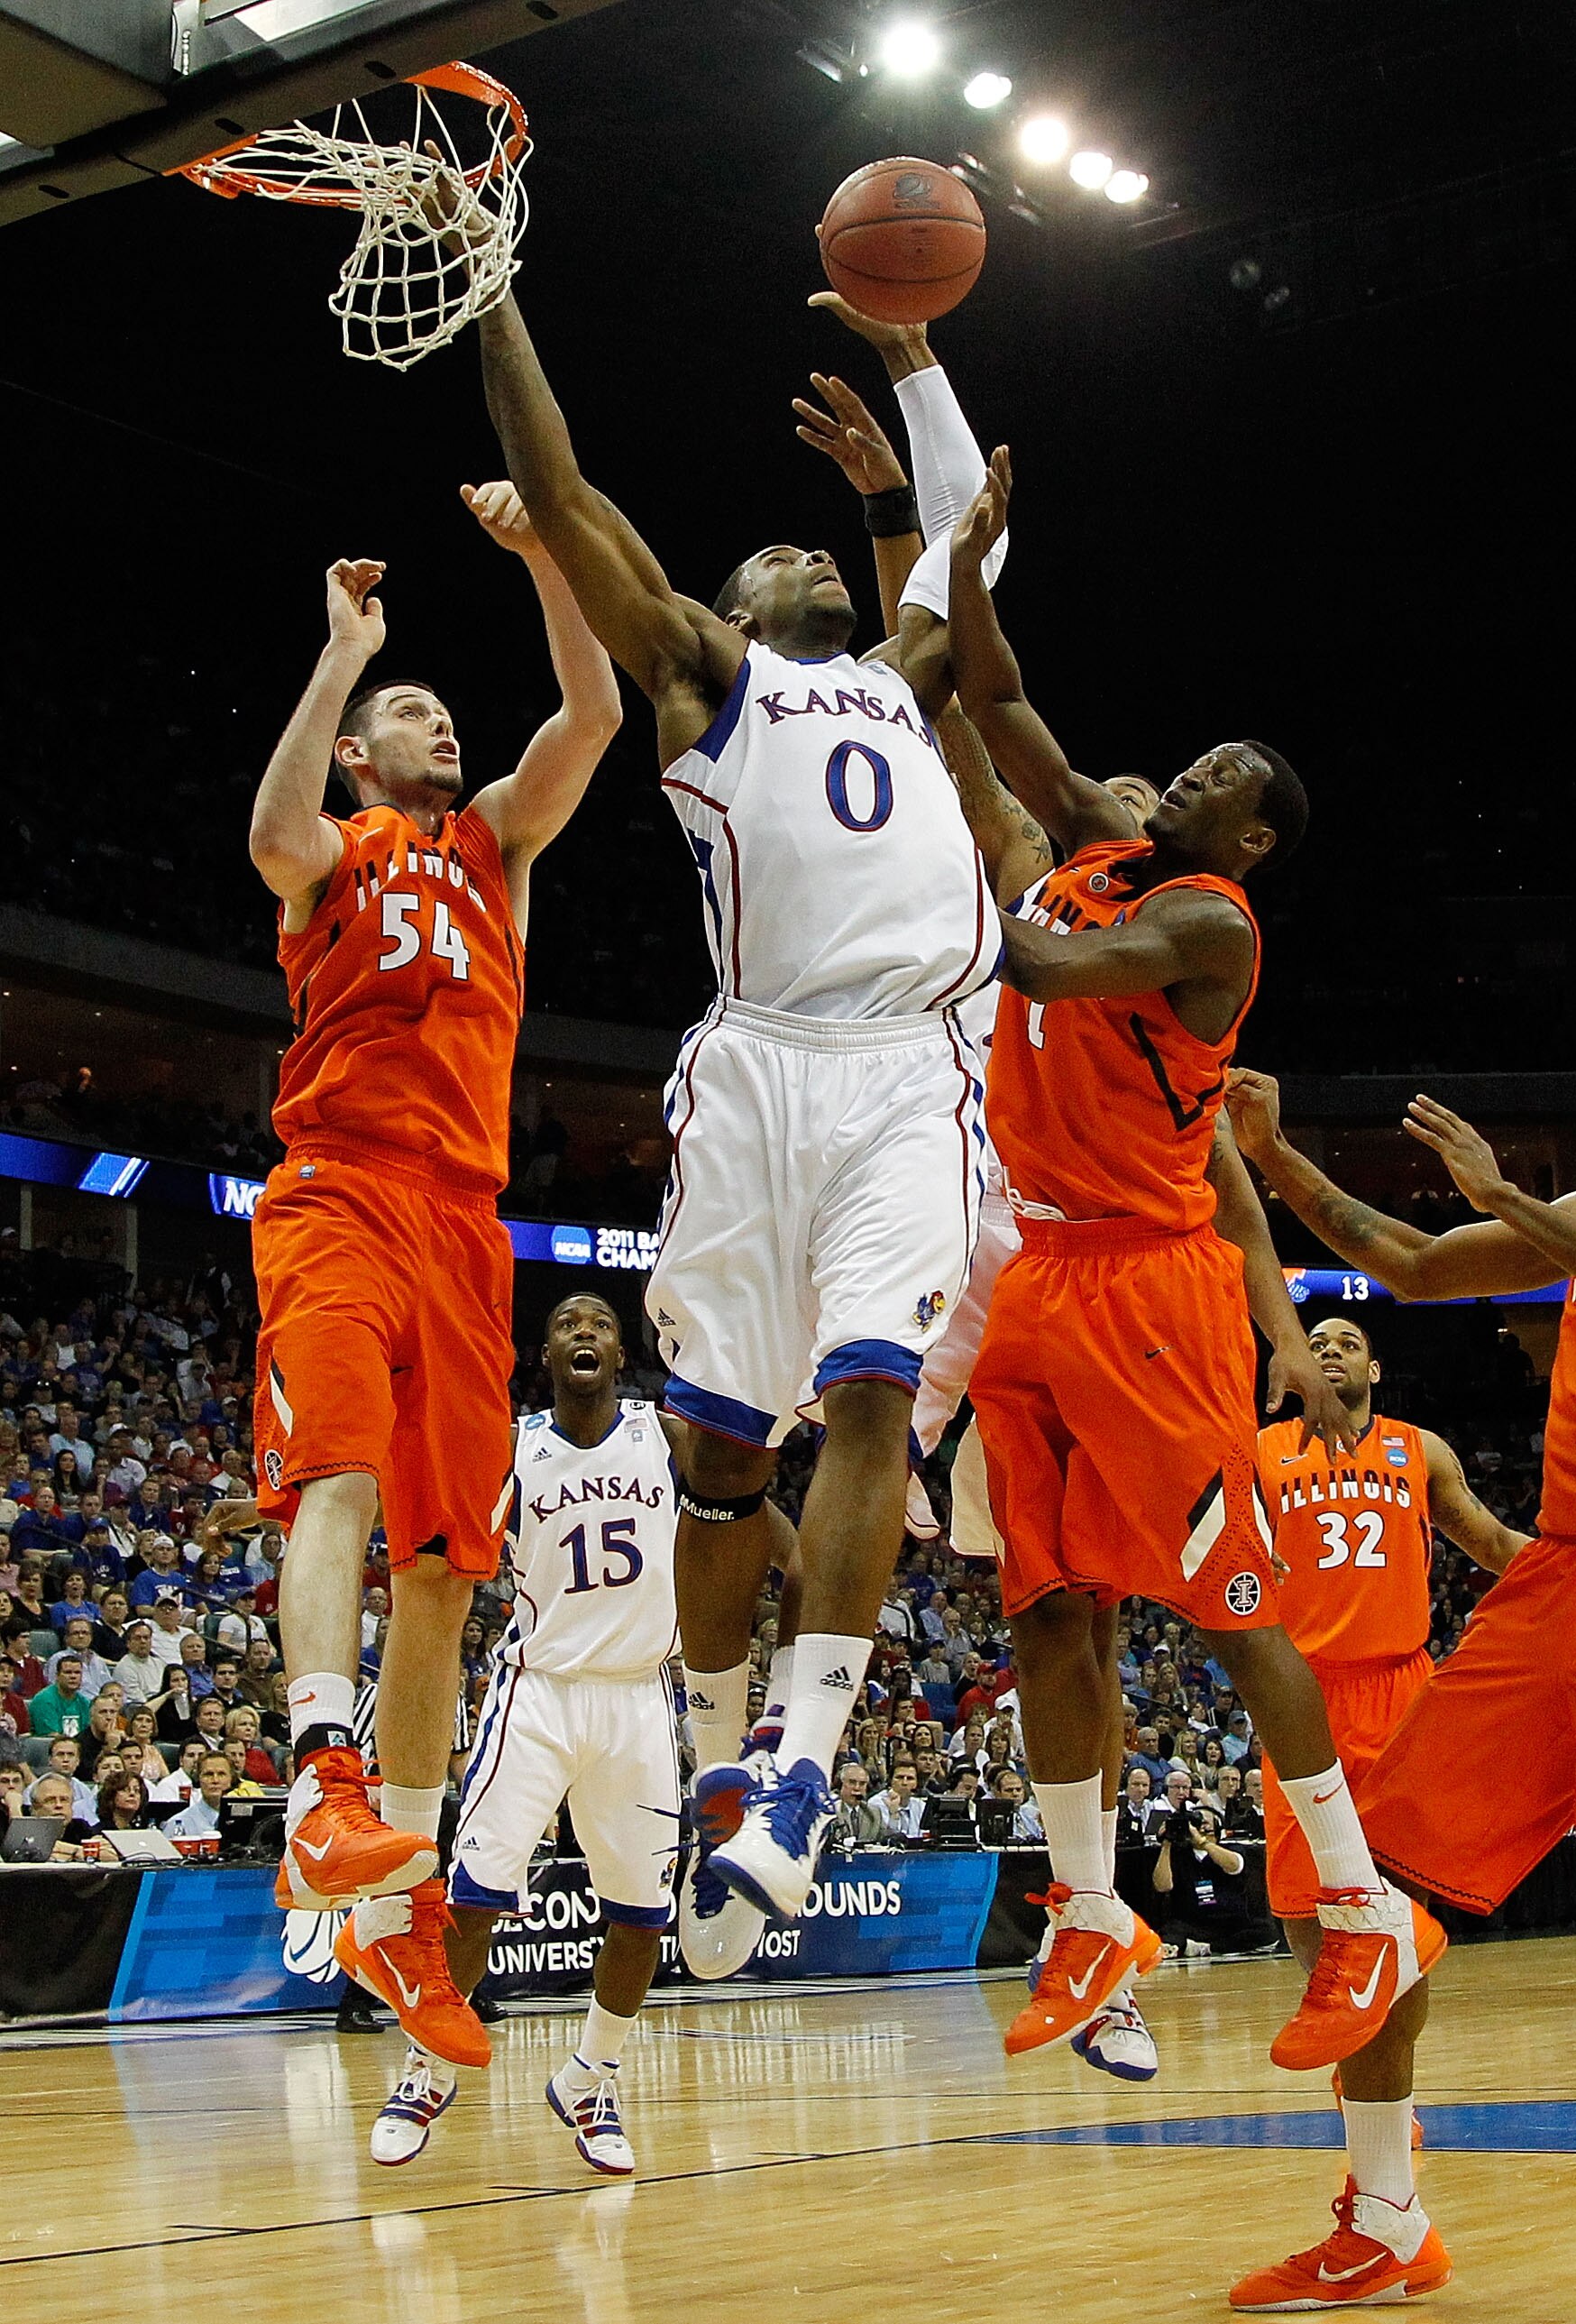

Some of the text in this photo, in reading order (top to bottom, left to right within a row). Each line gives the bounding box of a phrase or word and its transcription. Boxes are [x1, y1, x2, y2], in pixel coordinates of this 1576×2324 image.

[825, 739, 893, 832] 0
[379, 891, 471, 980] 54
[554, 1241, 591, 1259] NCAA
[596, 1227, 635, 1248] 2011
[1342, 1275, 1370, 1300] 13
[528, 1476, 664, 1524] KANSAS
[1280, 1468, 1412, 1515] ILLINOIS
[558, 1517, 644, 1594] 15
[1315, 1510, 1388, 1571] 32
[797, 1880, 902, 1918] OUNDS
